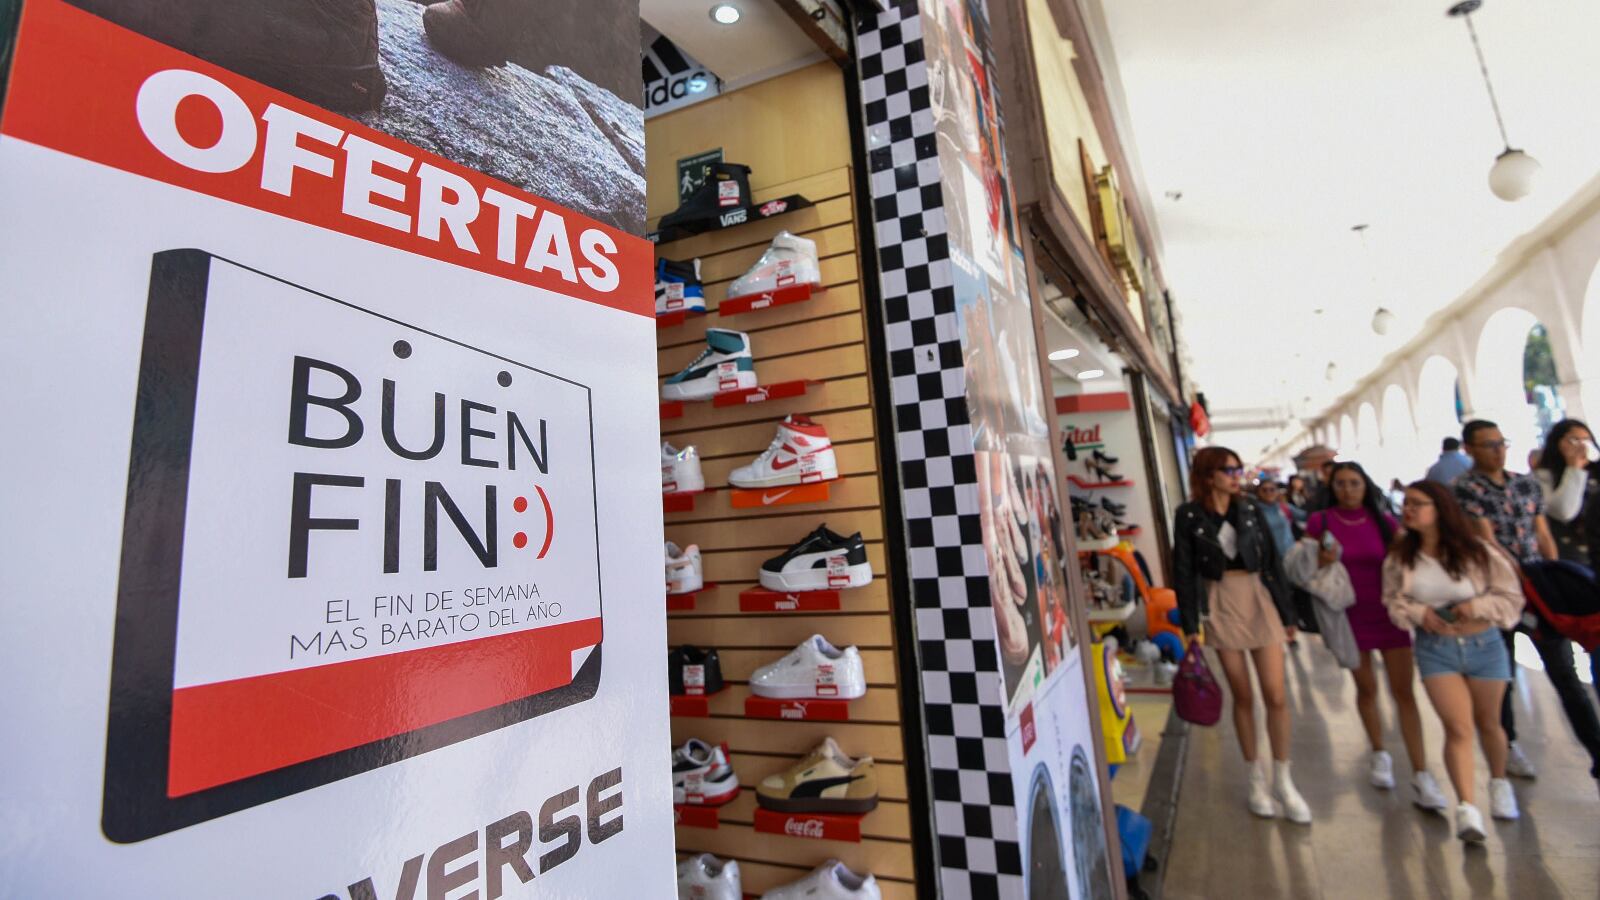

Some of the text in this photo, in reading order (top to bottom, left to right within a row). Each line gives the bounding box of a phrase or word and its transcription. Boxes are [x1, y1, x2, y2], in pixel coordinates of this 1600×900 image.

[136, 68, 620, 293] OFERTAS
[719, 209, 748, 227] VANS
[288, 354, 549, 475] BUEN
[290, 601, 562, 660] MAS BARATO DEL AÑO
[326, 583, 541, 624] EL FIN DE SEMANA
